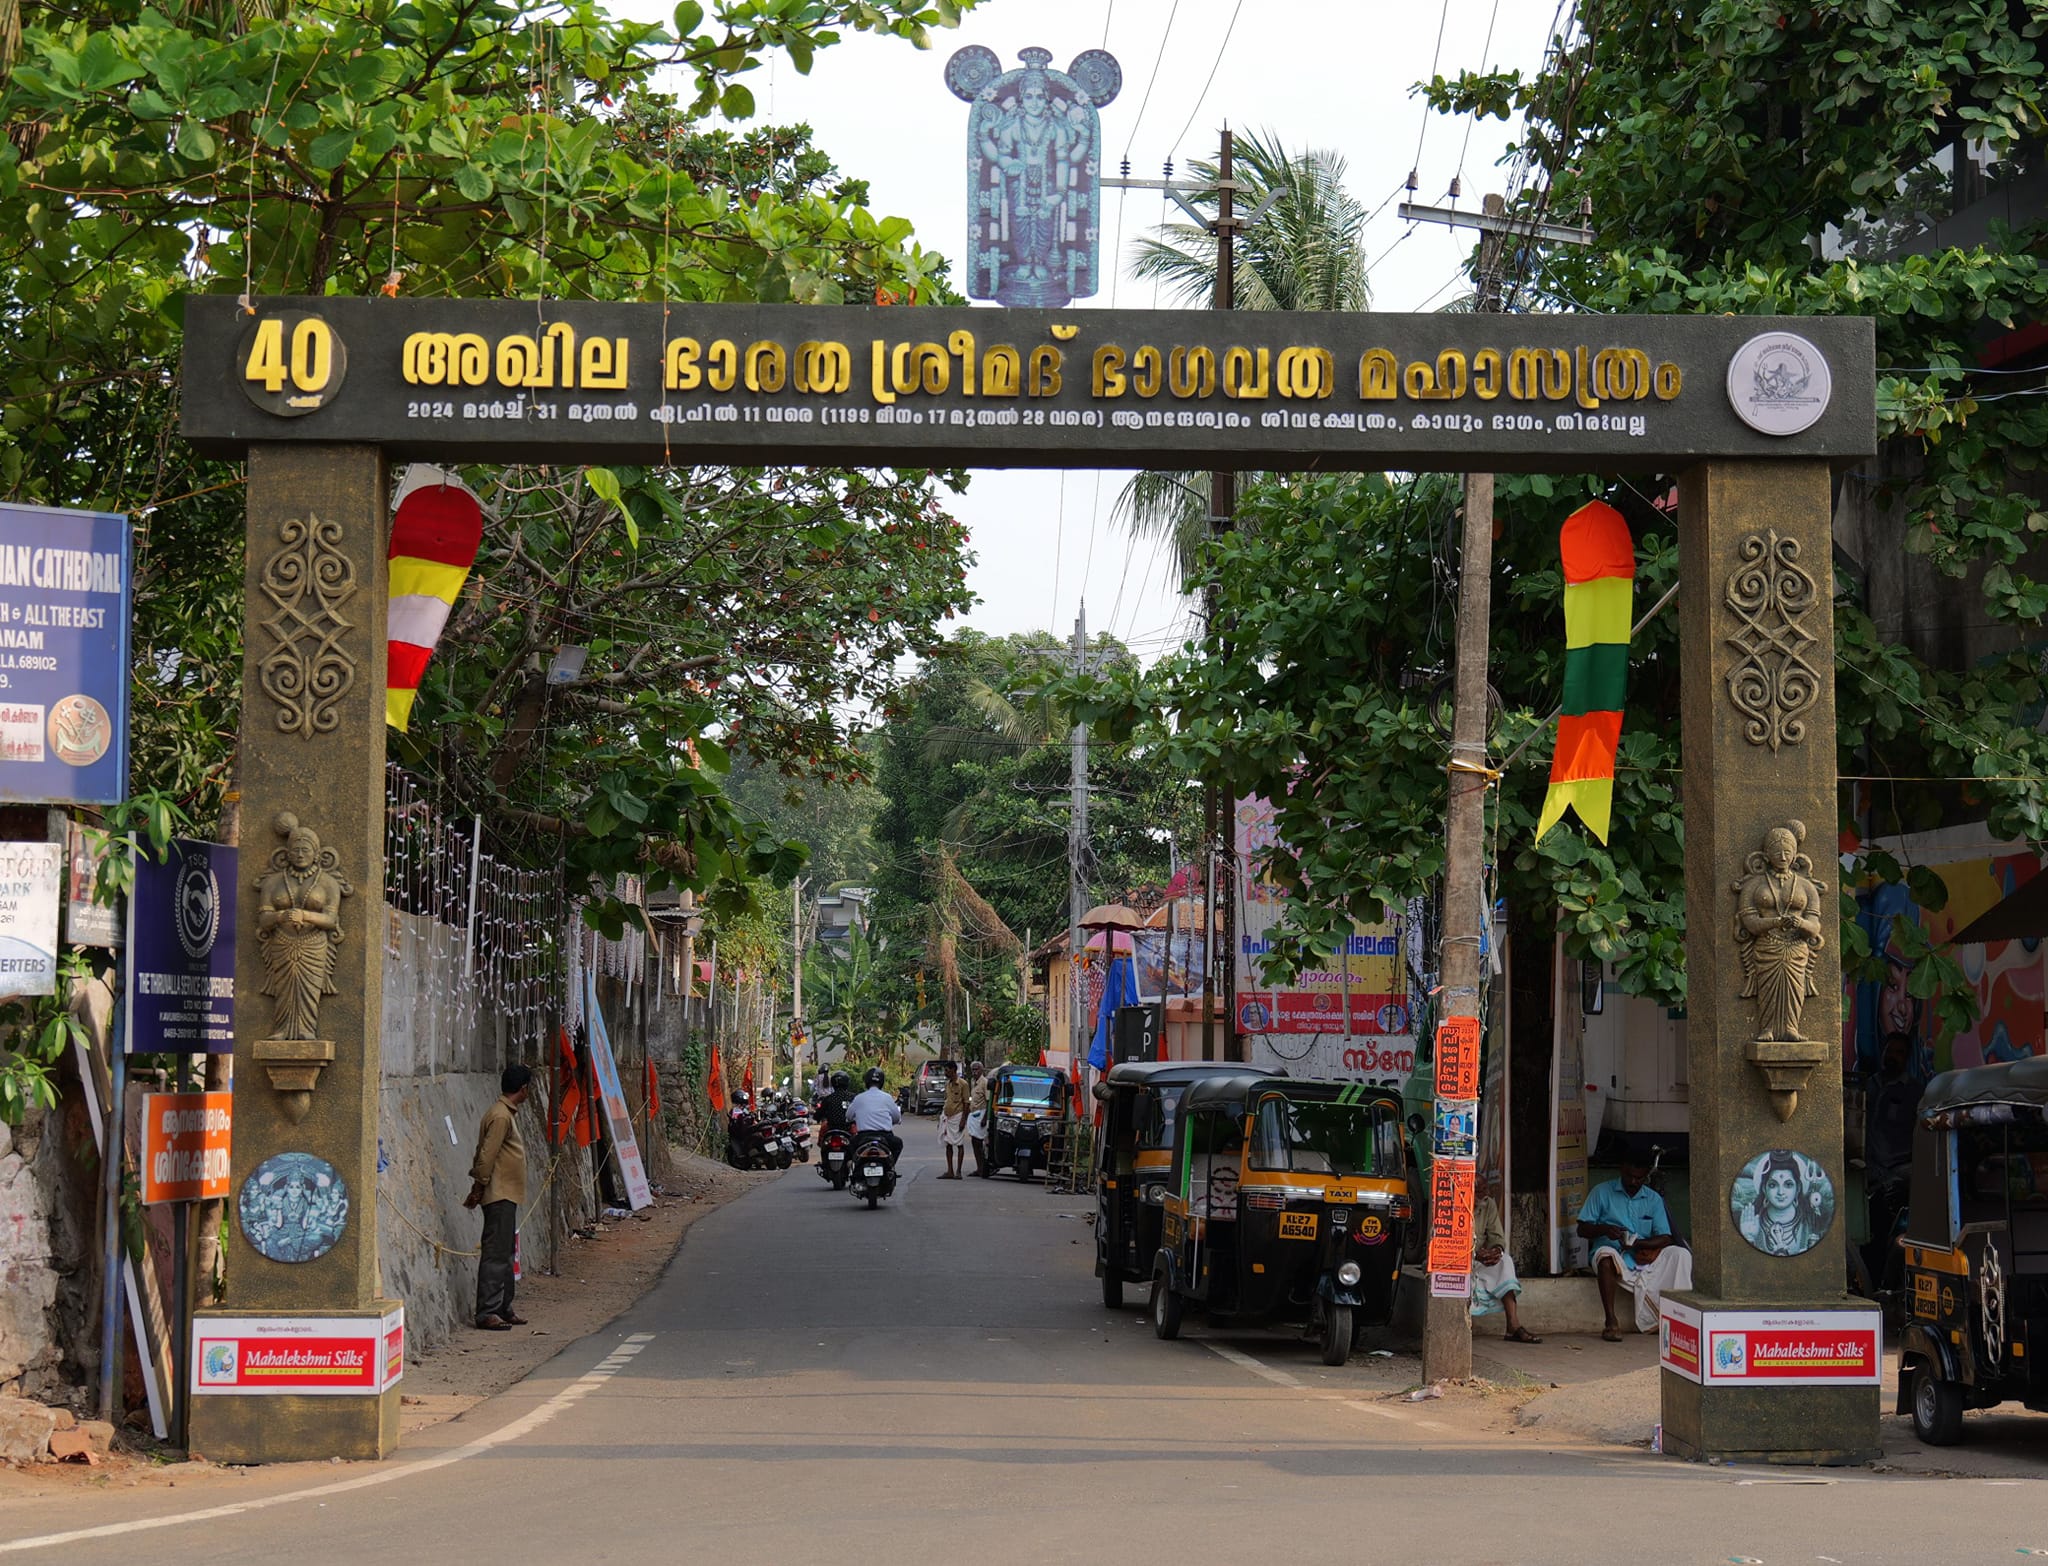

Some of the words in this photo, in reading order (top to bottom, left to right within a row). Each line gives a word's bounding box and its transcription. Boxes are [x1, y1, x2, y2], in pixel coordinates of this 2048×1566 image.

[246, 318, 332, 392] 40
[402, 321, 629, 390] അഖില
[665, 337, 852, 394] ഭാരത
[871, 325, 1078, 403] ശ്രീമദ്
[1092, 345, 1334, 399] ഭാഗവത
[1359, 345, 1682, 409] മഹാസത്രം
[407, 402, 453, 418] 2024
[463, 393, 524, 420] മാർച്ച്
[538, 405, 557, 419] 31
[569, 402, 638, 423] മുതൽ
[650, 403, 737, 424] ഏപ്രിൽ
[744, 406, 760, 422] 11
[767, 406, 813, 423] വരെ
[821, 406, 869, 425] (1199
[875, 405, 923, 424] മീനം
[928, 409, 945, 424] 17
[951, 408, 1018, 427] മുതൽ
[1022, 409, 1044, 424] 28
[1050, 410, 1104, 427] വരെ)
[1411, 415, 1483, 432] കാവും
[1555, 413, 1646, 436] തിരുവല്ല
[32, 548, 121, 593] CATHEDRAL
[12, 607, 21, 620] &
[24, 604, 48, 626] ALL
[49, 605, 71, 627] THE
[72, 607, 105, 629] EAST
[0, 958, 46, 973] ERTERS
[1463, 1047, 1471, 1060] 7
[1463, 1070, 1471, 1084] 8
[1329, 1190, 1353, 1199] TAXI
[1458, 1214, 1466, 1228] 8
[1753, 1342, 1834, 1358] Mahalekshmi
[1836, 1342, 1865, 1358] Silks
[245, 1350, 332, 1367] Mahalekshmi
[333, 1350, 364, 1367] Silks
